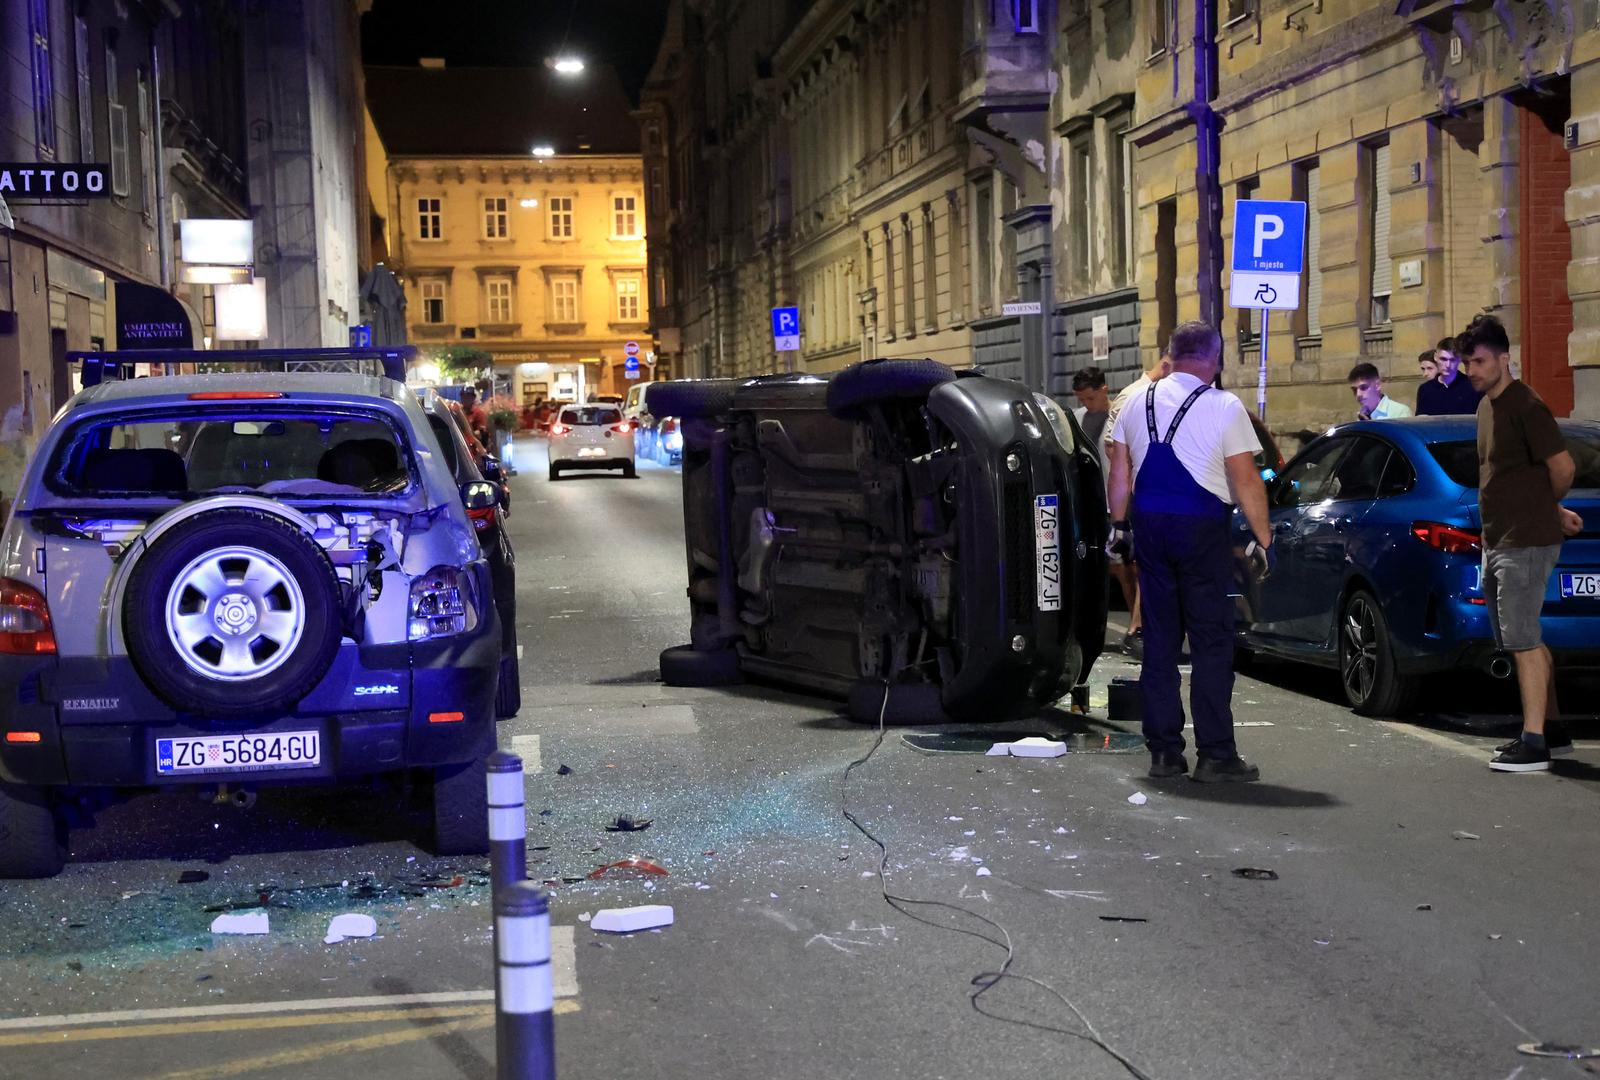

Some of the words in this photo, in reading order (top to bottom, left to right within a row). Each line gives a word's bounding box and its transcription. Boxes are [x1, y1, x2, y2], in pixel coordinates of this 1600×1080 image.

[1253, 214, 1285, 258] P
[1260, 260, 1284, 270] mjesto
[780, 313, 791, 331] P
[1041, 508, 1057, 530] ZG
[1574, 576, 1596, 594] ZG
[63, 698, 120, 710] RENAULT
[160, 758, 173, 767] HR
[175, 741, 206, 767] ZG
